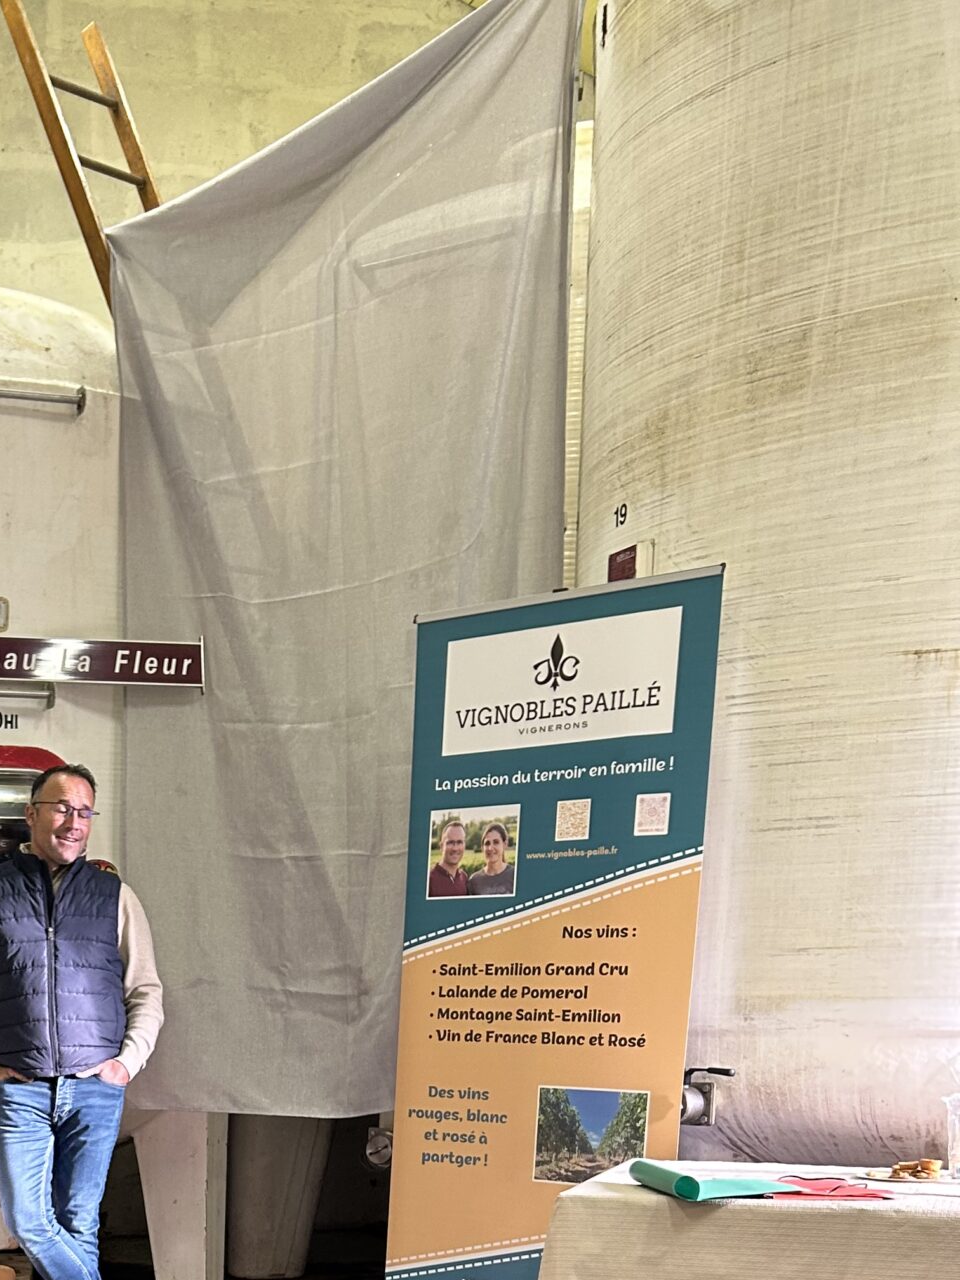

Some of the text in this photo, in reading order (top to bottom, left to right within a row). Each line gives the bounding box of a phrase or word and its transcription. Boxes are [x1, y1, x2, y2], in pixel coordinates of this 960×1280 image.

[613, 503, 628, 528] 19
[61, 648, 91, 674] La
[113, 649, 193, 677] Fleur
[455, 681, 662, 729] VIGNOBLES PAILLÉ
[435, 777, 452, 792] La
[453, 774, 510, 793] passion
[511, 770, 532, 784] du
[534, 766, 587, 782] terroir
[589, 763, 608, 777] en
[610, 756, 667, 776] famille
[526, 845, 619, 860] www.vignobles-paille.fr
[562, 926, 593, 939] Nos
[596, 924, 629, 938] vins
[439, 962, 629, 977] Saint-Emilion Grand Cru
[438, 985, 589, 999] Lalande de Pomerol
[437, 1008, 621, 1024] Montagne Saint-Emilion
[436, 1030, 647, 1048] Vin de France Blanc et Rosé
[428, 1085, 490, 1101] Des vins
[408, 1107, 508, 1125] rouges, blanc
[424, 1129, 489, 1145] et rosé à
[421, 1151, 482, 1166] partger
